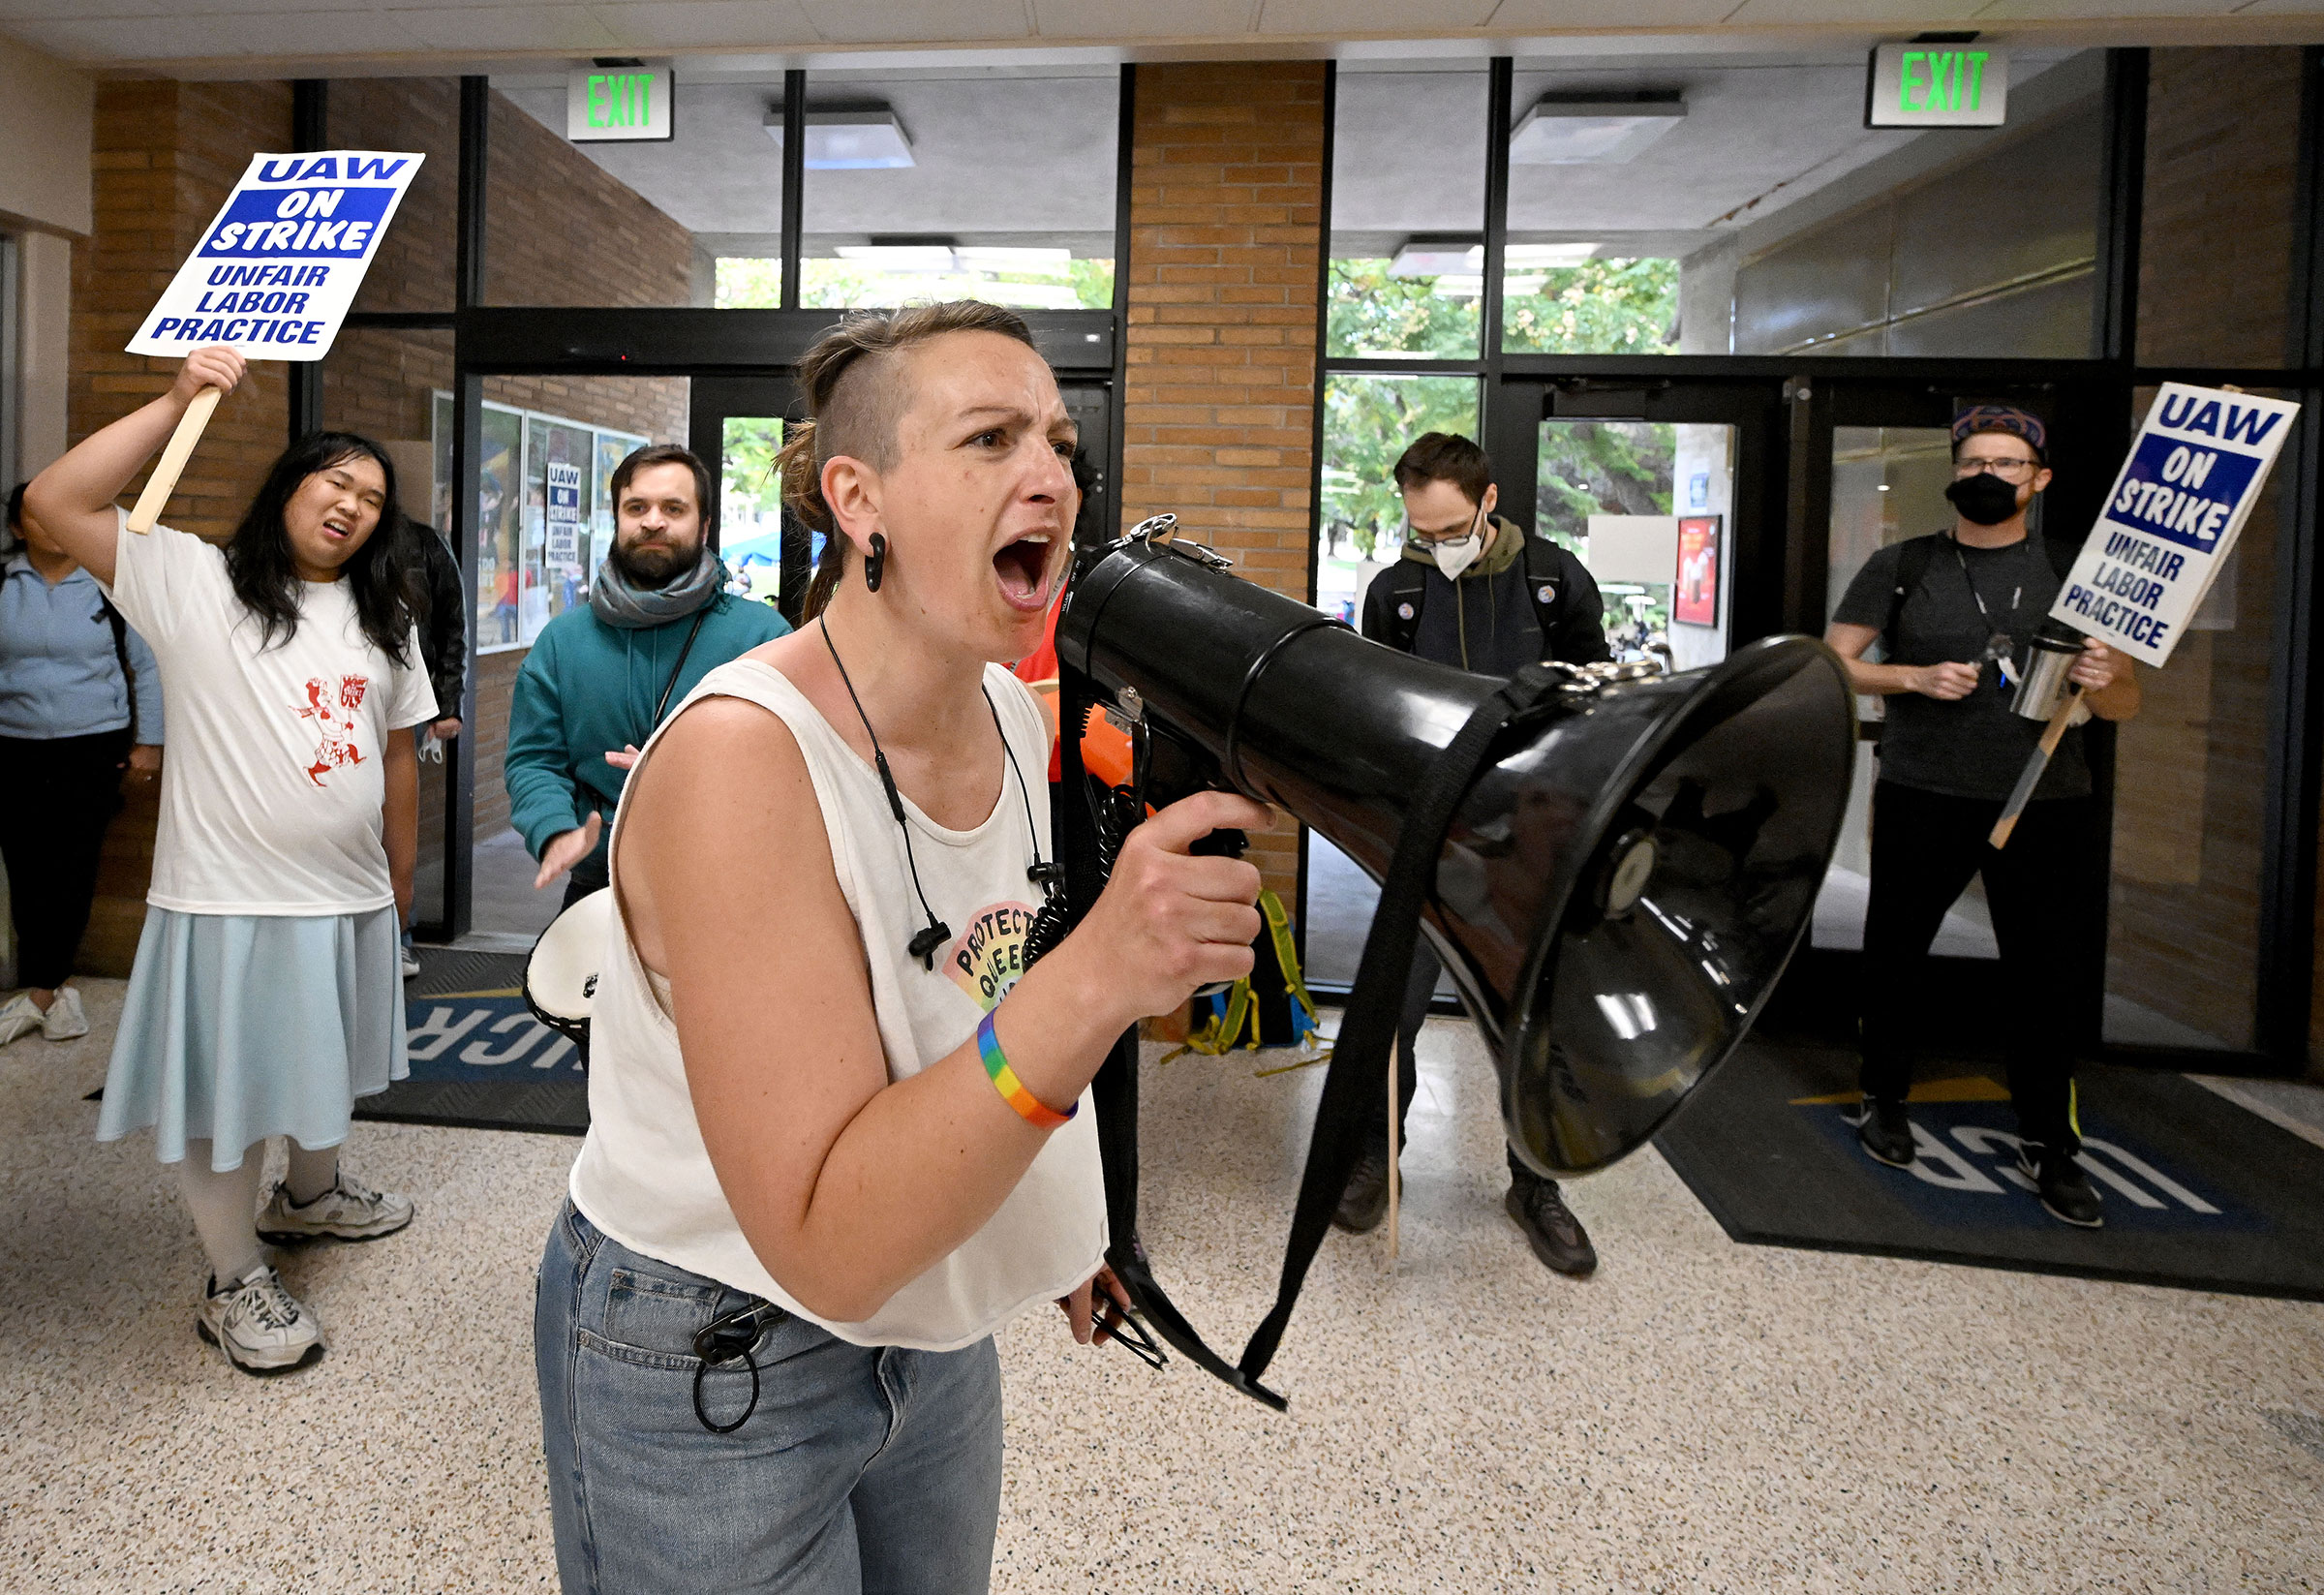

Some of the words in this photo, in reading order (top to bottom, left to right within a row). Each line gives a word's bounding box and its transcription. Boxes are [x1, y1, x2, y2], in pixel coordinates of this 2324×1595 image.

[1900, 51, 1990, 111] EXIT
[588, 74, 656, 127] EXIT
[258, 157, 410, 182] UAW
[276, 189, 345, 219] ON
[210, 220, 373, 251] STRIKE
[206, 265, 330, 287] UNFAIR
[195, 291, 310, 314] LABOR
[150, 317, 326, 345] PRACTICE
[2158, 393, 2283, 446] UAW
[549, 468, 579, 485] UAW
[2161, 445, 2217, 490] ON
[557, 489, 569, 505] ON
[2115, 478, 2230, 541] STRIKE
[549, 504, 577, 522] STRIKE
[548, 551, 575, 562] PRACTICE
[552, 538, 571, 549] LABOR
[2105, 531, 2186, 582] UNFAIR
[2092, 561, 2164, 611] LABOR
[2064, 584, 2169, 650] PRACTICE
[956, 908, 1035, 977] PROTECT
[979, 943, 1023, 998] QUEE
